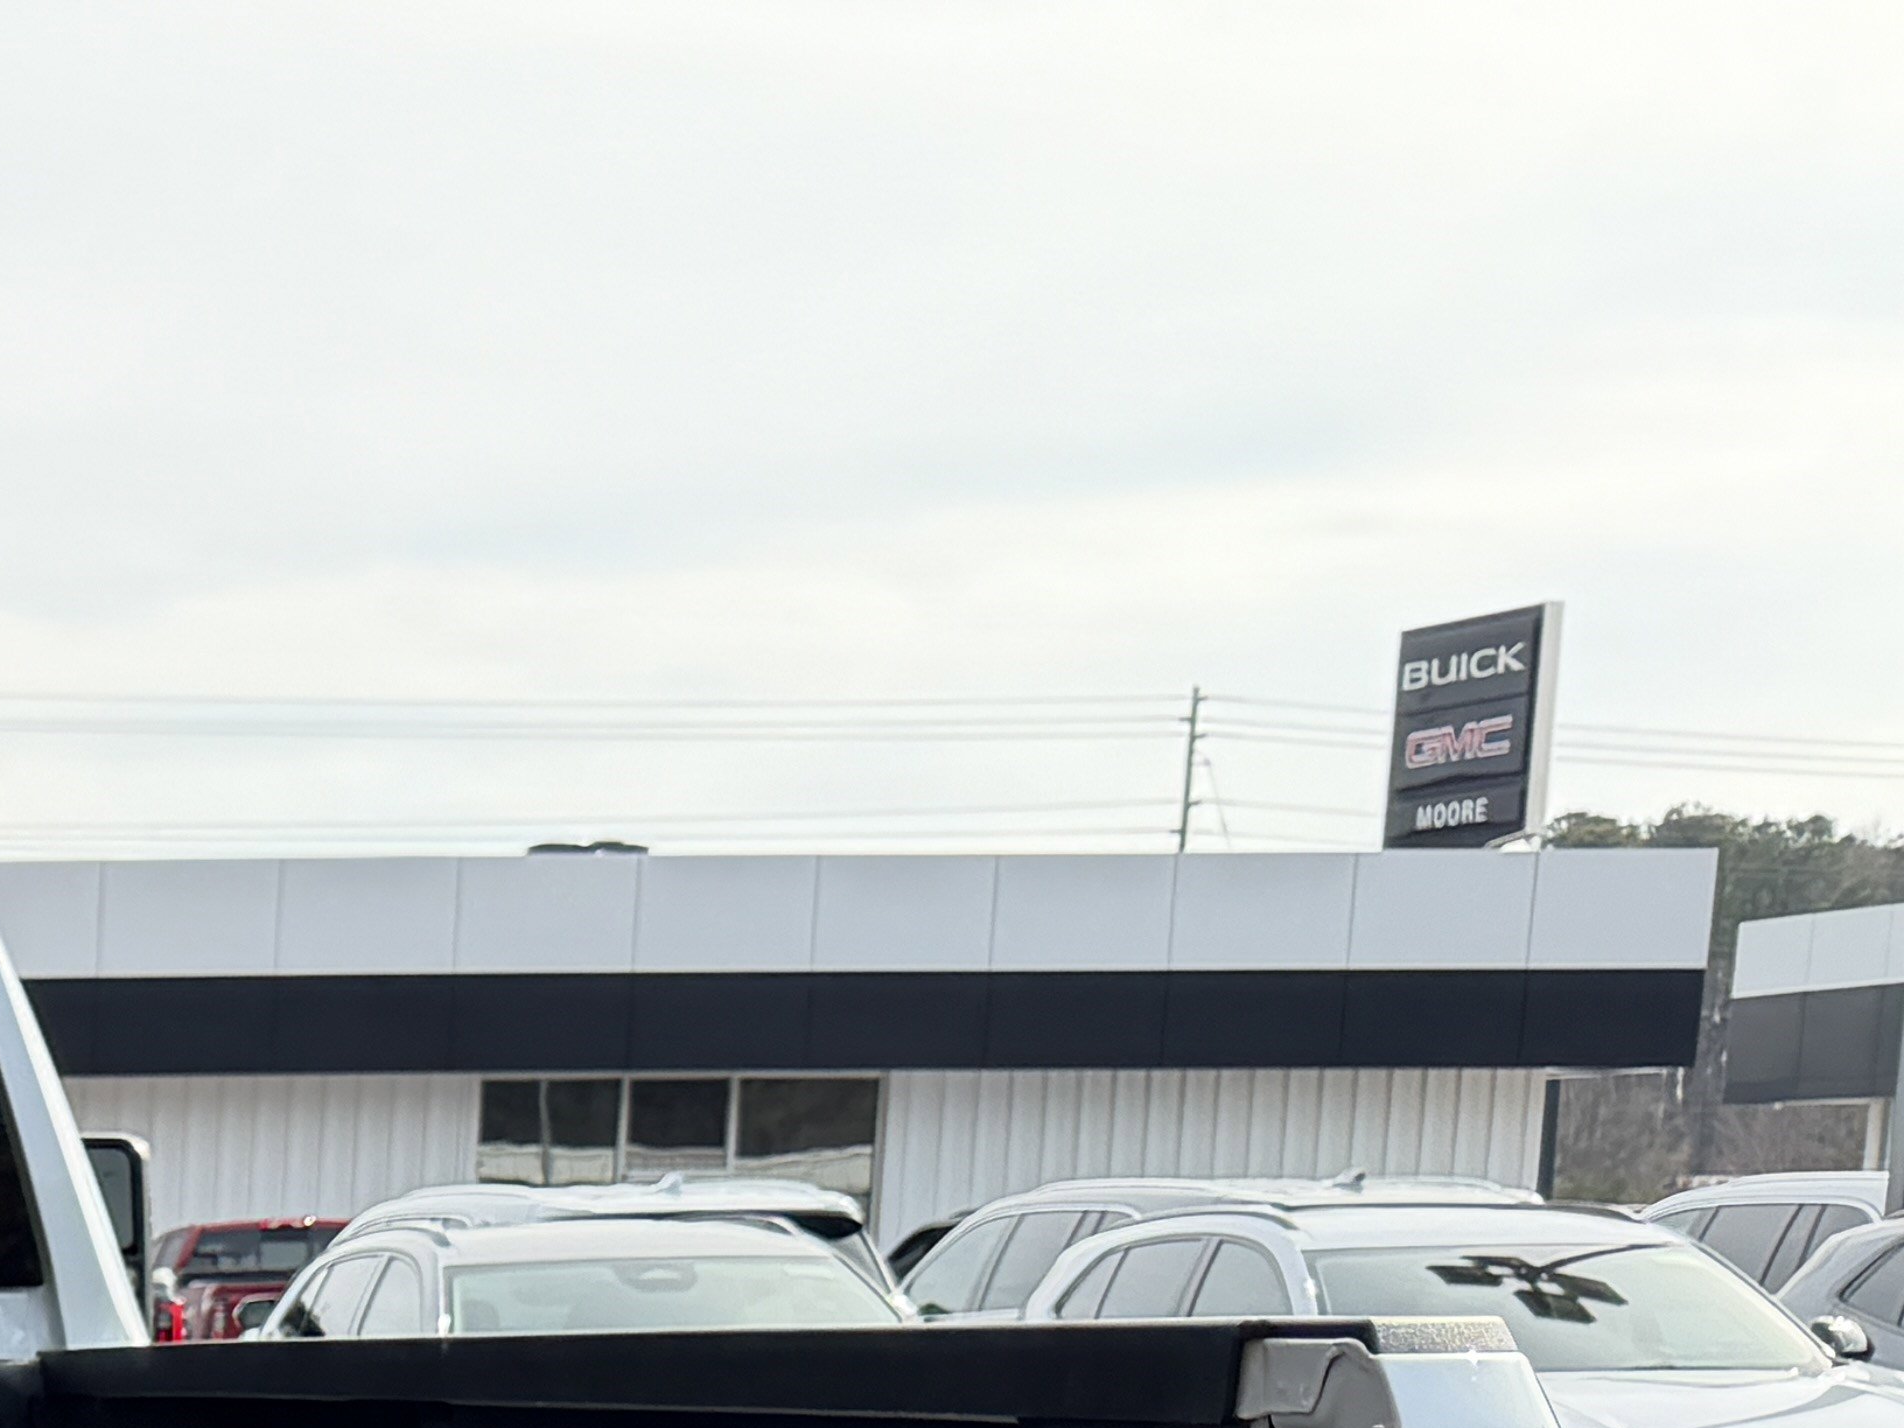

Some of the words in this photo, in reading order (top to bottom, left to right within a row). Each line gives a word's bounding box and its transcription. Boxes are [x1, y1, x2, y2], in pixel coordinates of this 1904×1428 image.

[1402, 641, 1526, 691] BUICK
[1405, 714, 1513, 769] GMC
[1415, 797, 1489, 831] MOORE
